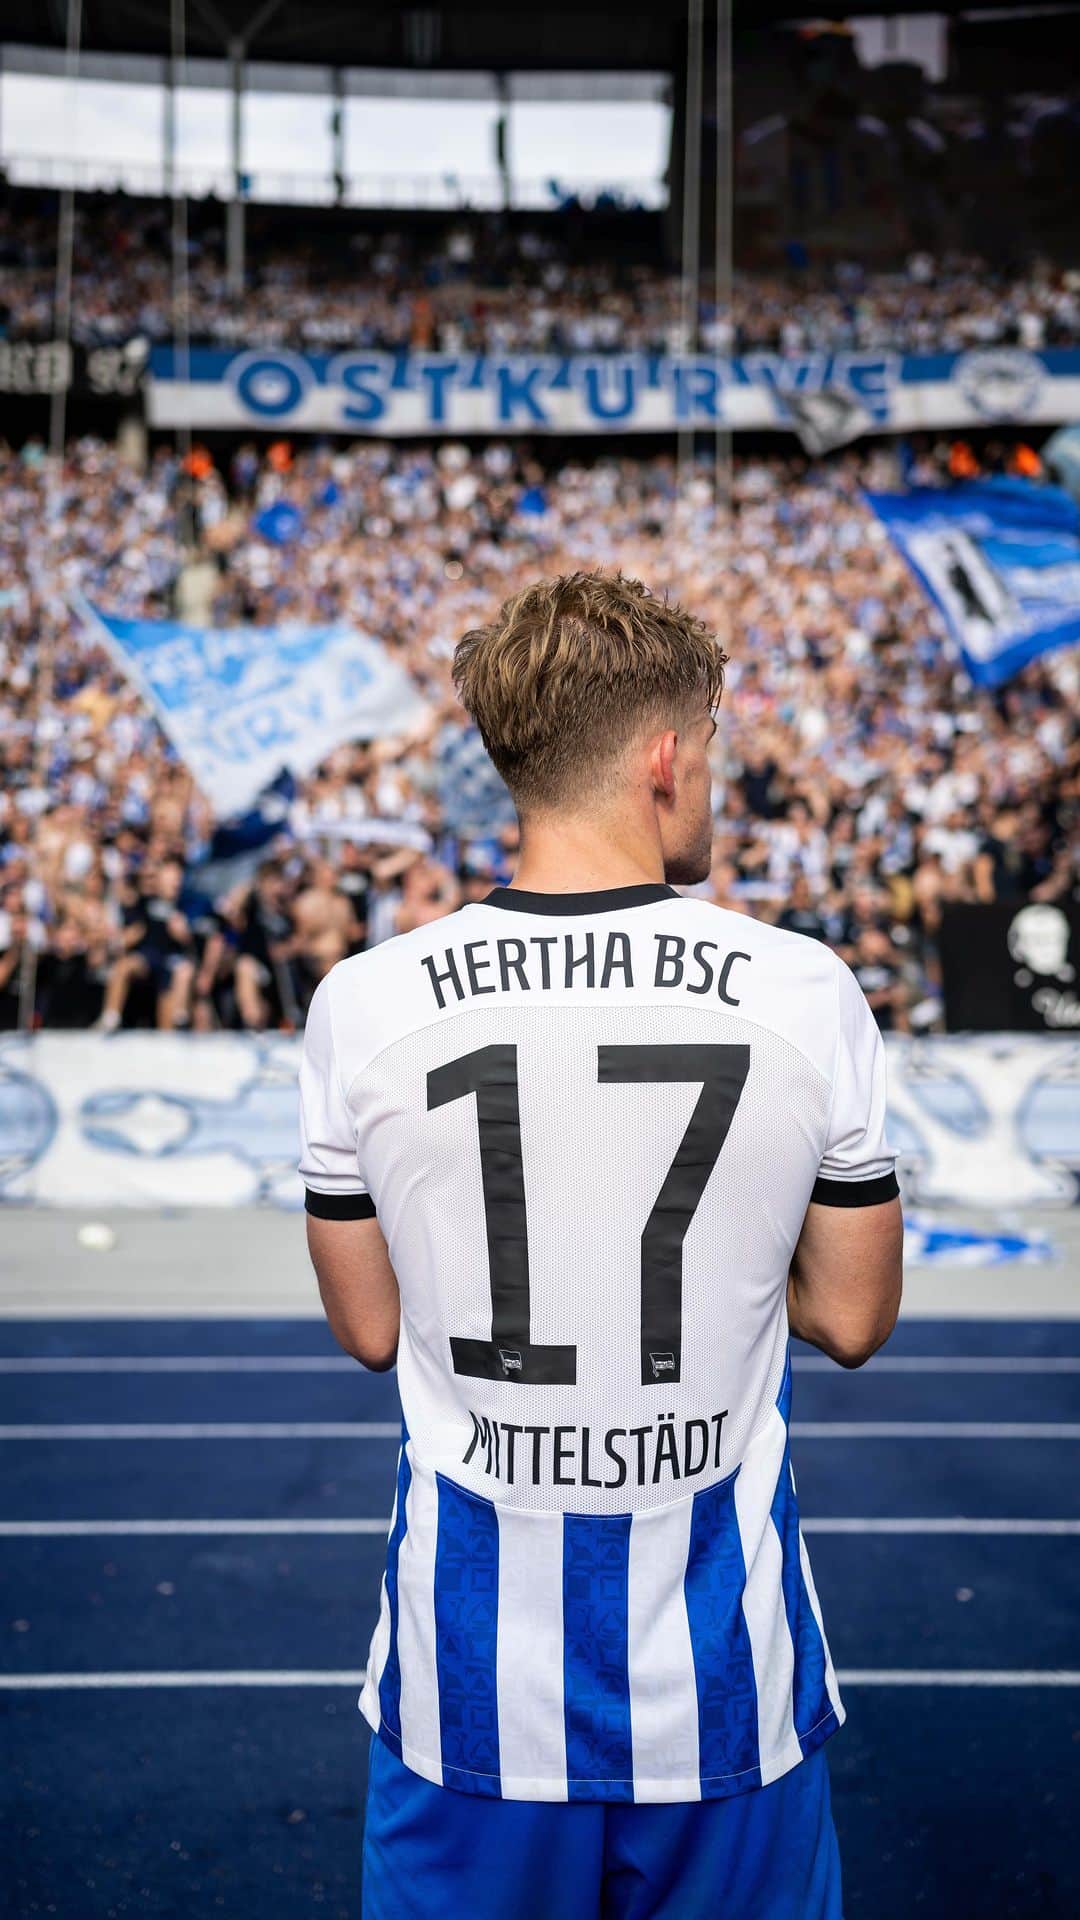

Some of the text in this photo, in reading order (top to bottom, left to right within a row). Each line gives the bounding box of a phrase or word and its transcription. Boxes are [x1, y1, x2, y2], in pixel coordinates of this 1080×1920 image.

[230, 354, 893, 427] OSTKURVE
[420, 932, 752, 1009] HERTHA BSC
[426, 1043, 751, 1387] 17
[461, 1408, 730, 1490] MITTELSTÄDT
